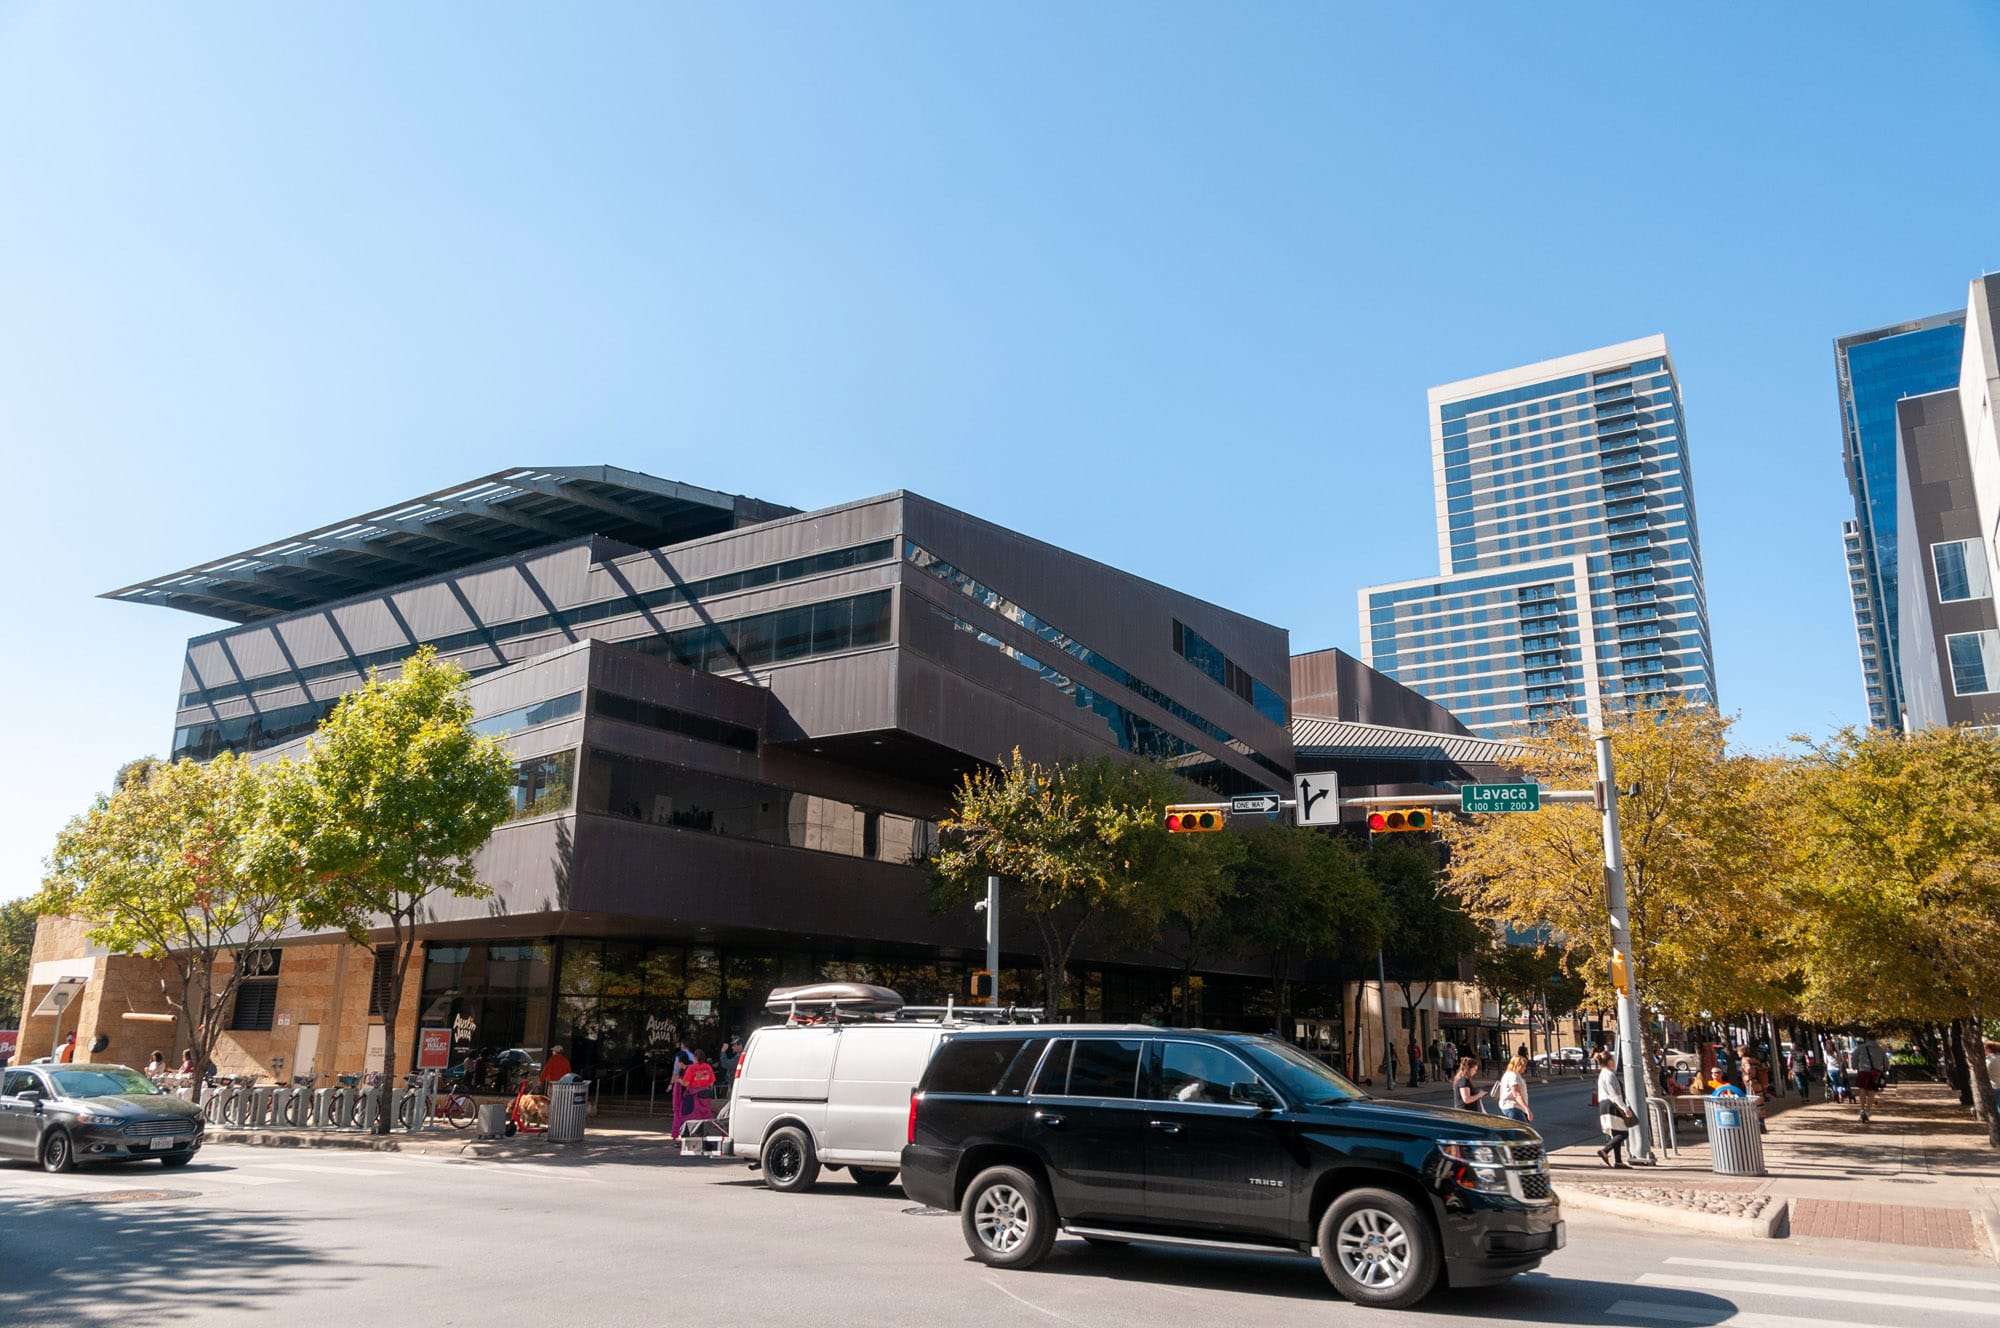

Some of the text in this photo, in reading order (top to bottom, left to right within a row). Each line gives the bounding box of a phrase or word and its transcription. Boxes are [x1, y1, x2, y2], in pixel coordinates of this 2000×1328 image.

[1473, 786, 1527, 800] Lavaca
[1475, 802, 1526, 811] 100 ST 200
[646, 1014, 676, 1032] Austin
[1249, 1177, 1284, 1187] TAHOE
